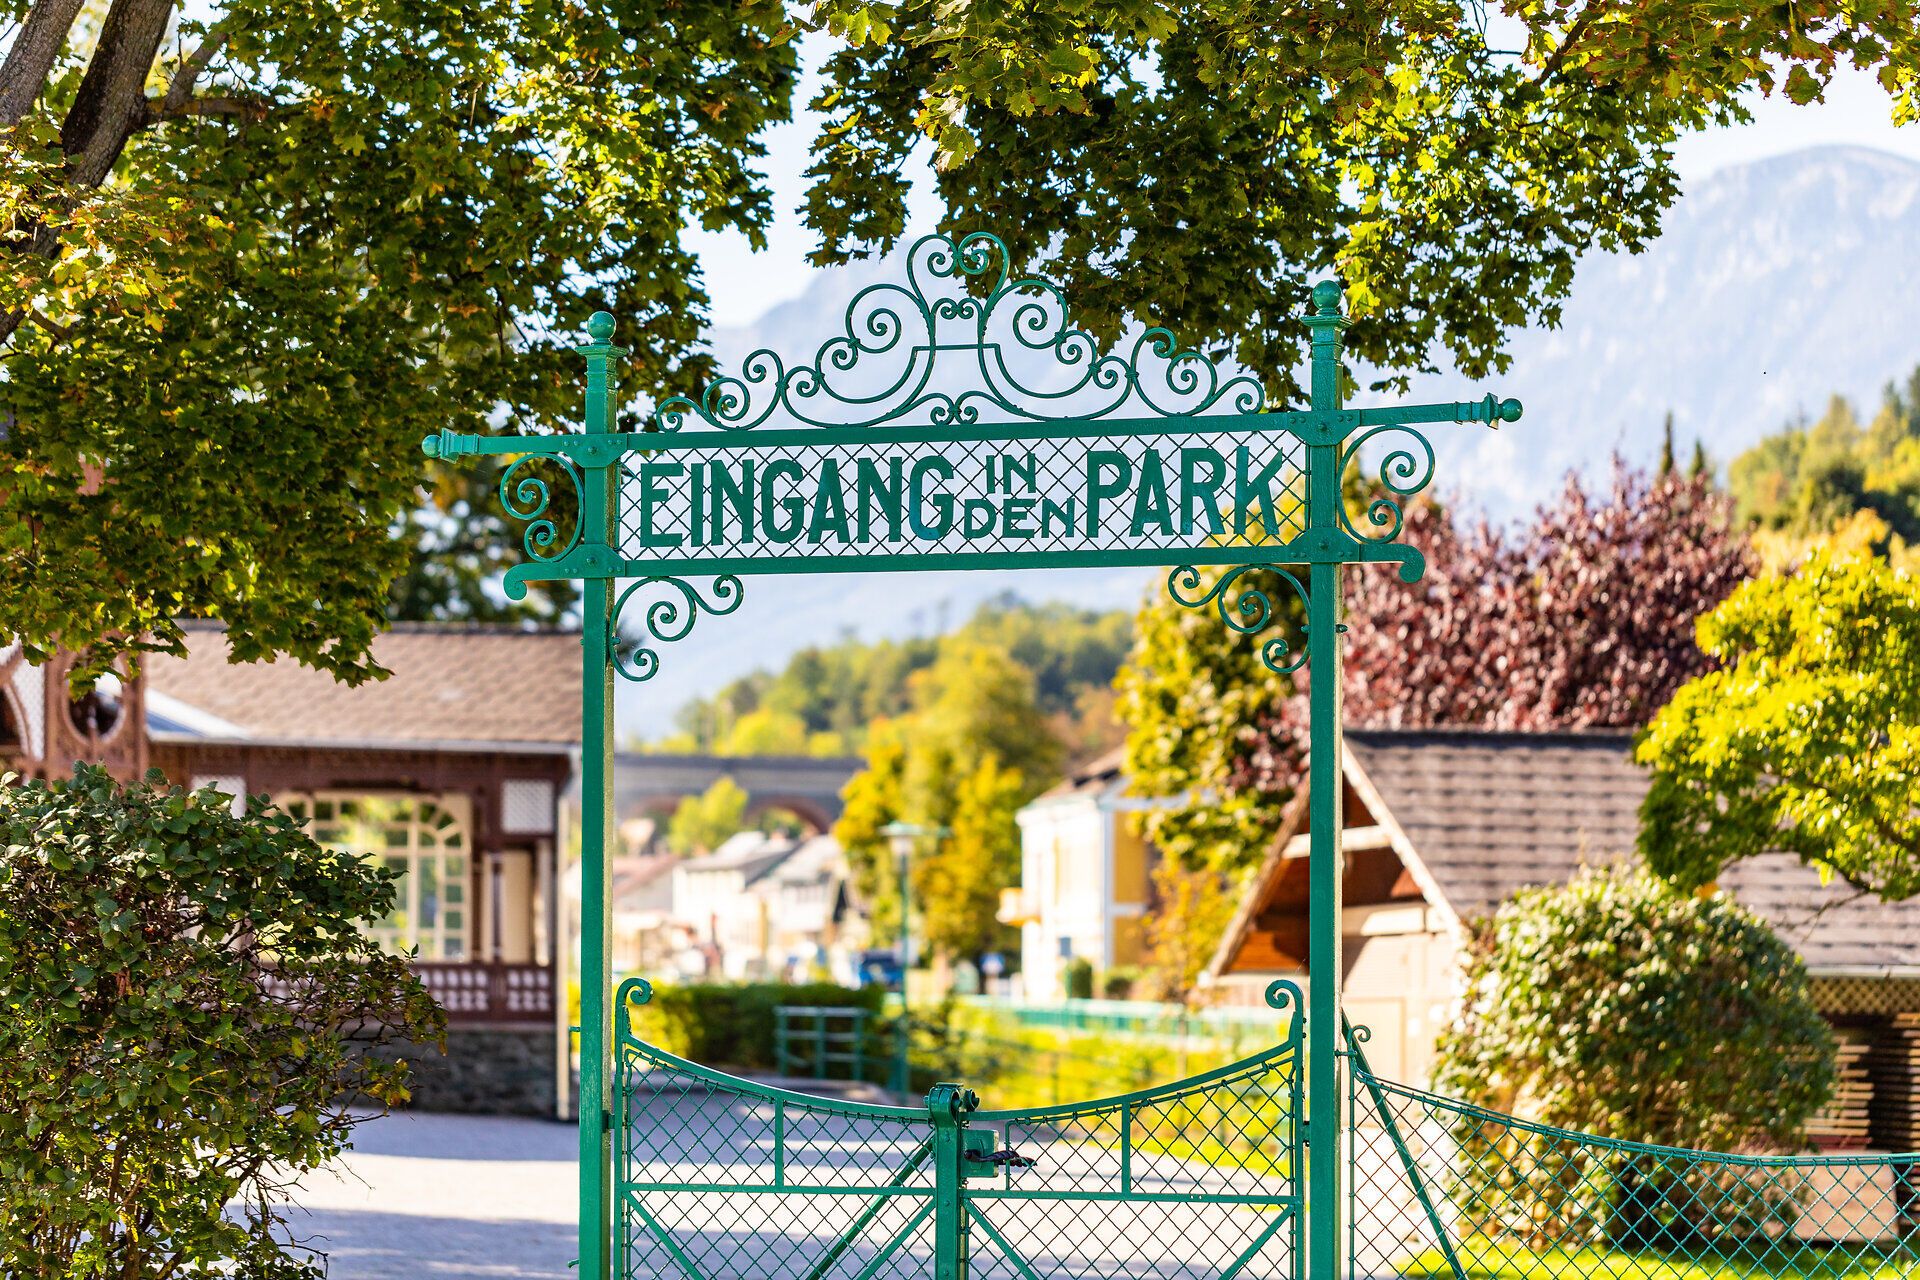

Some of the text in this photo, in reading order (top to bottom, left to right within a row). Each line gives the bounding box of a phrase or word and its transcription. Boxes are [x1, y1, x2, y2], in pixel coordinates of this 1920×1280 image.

[640, 455, 954, 547] EINGANG
[986, 453, 1036, 494] IN
[1087, 446, 1283, 538] PARK
[964, 498, 1075, 539] DEN
